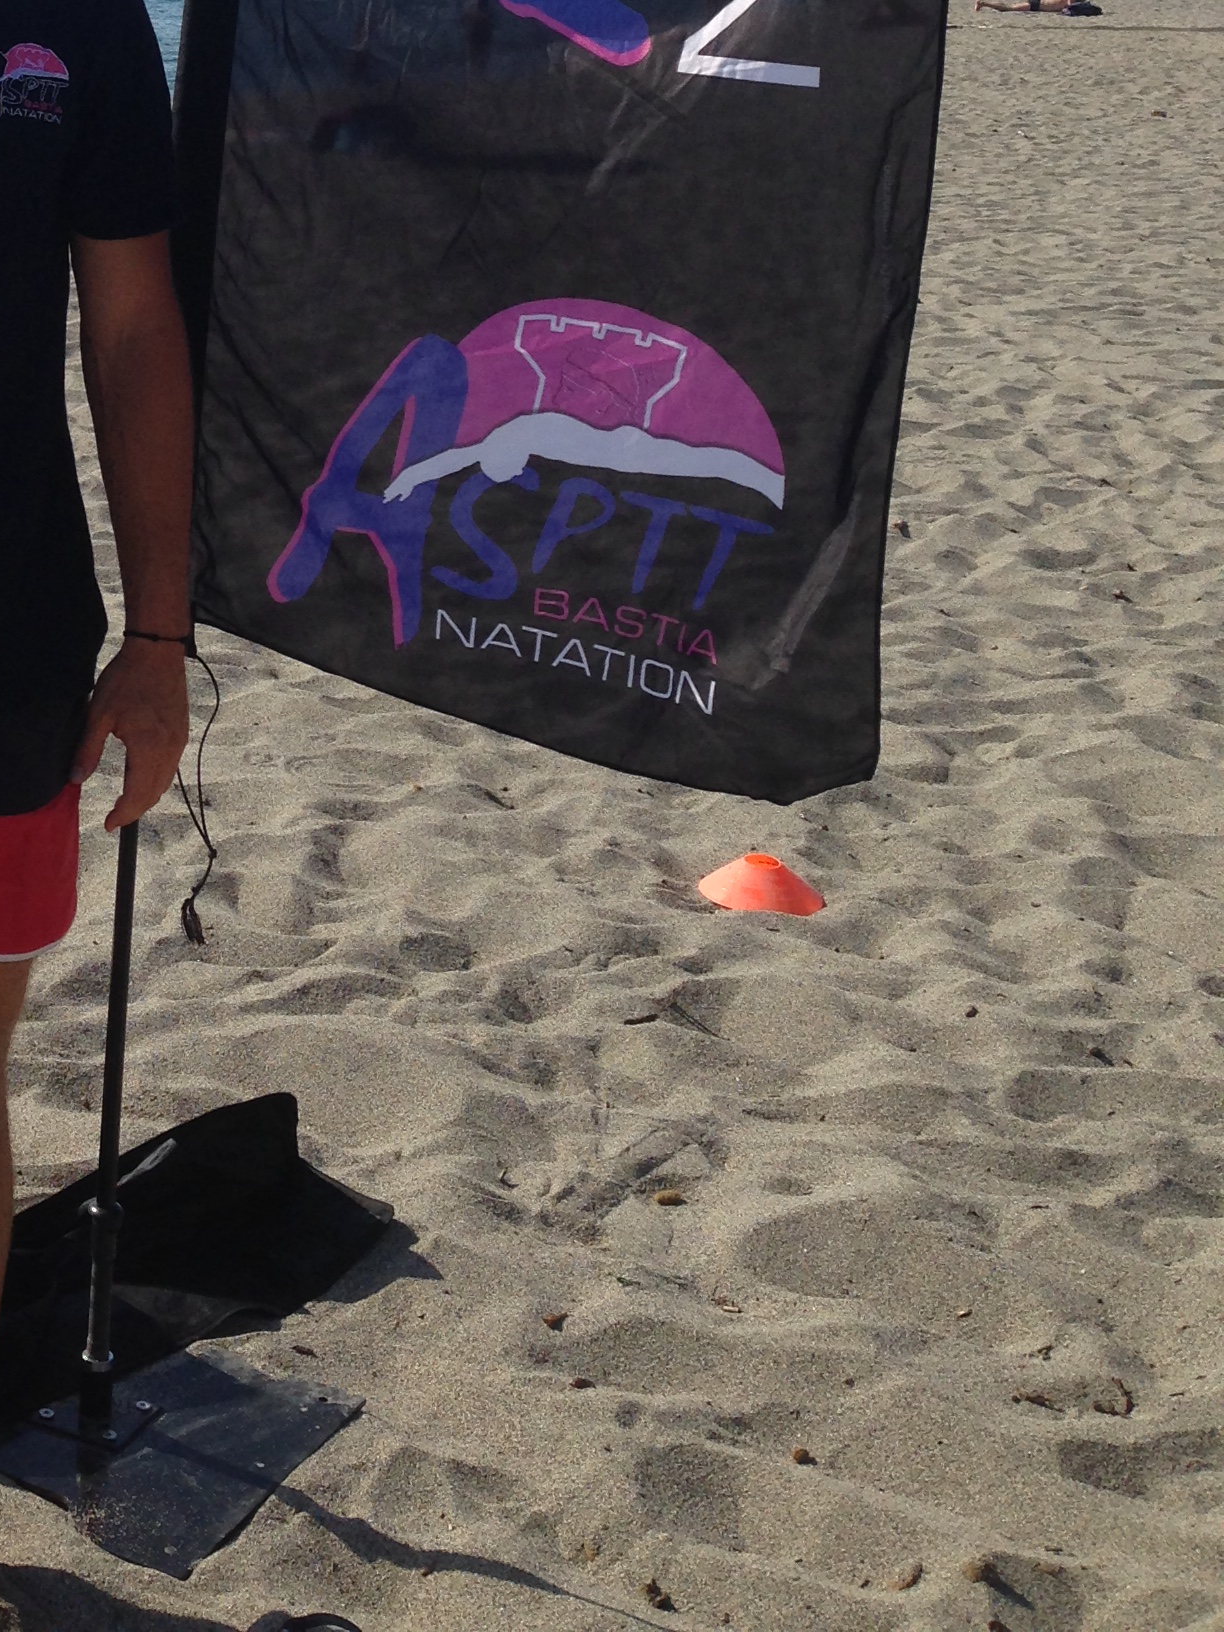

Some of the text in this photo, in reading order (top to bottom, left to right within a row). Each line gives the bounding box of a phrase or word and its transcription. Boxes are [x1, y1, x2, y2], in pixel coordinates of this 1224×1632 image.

[2, 106, 63, 125] NATATION
[266, 333, 774, 650] ASPTT
[435, 608, 717, 715] NATATION
[533, 588, 718, 665] BASTIA
